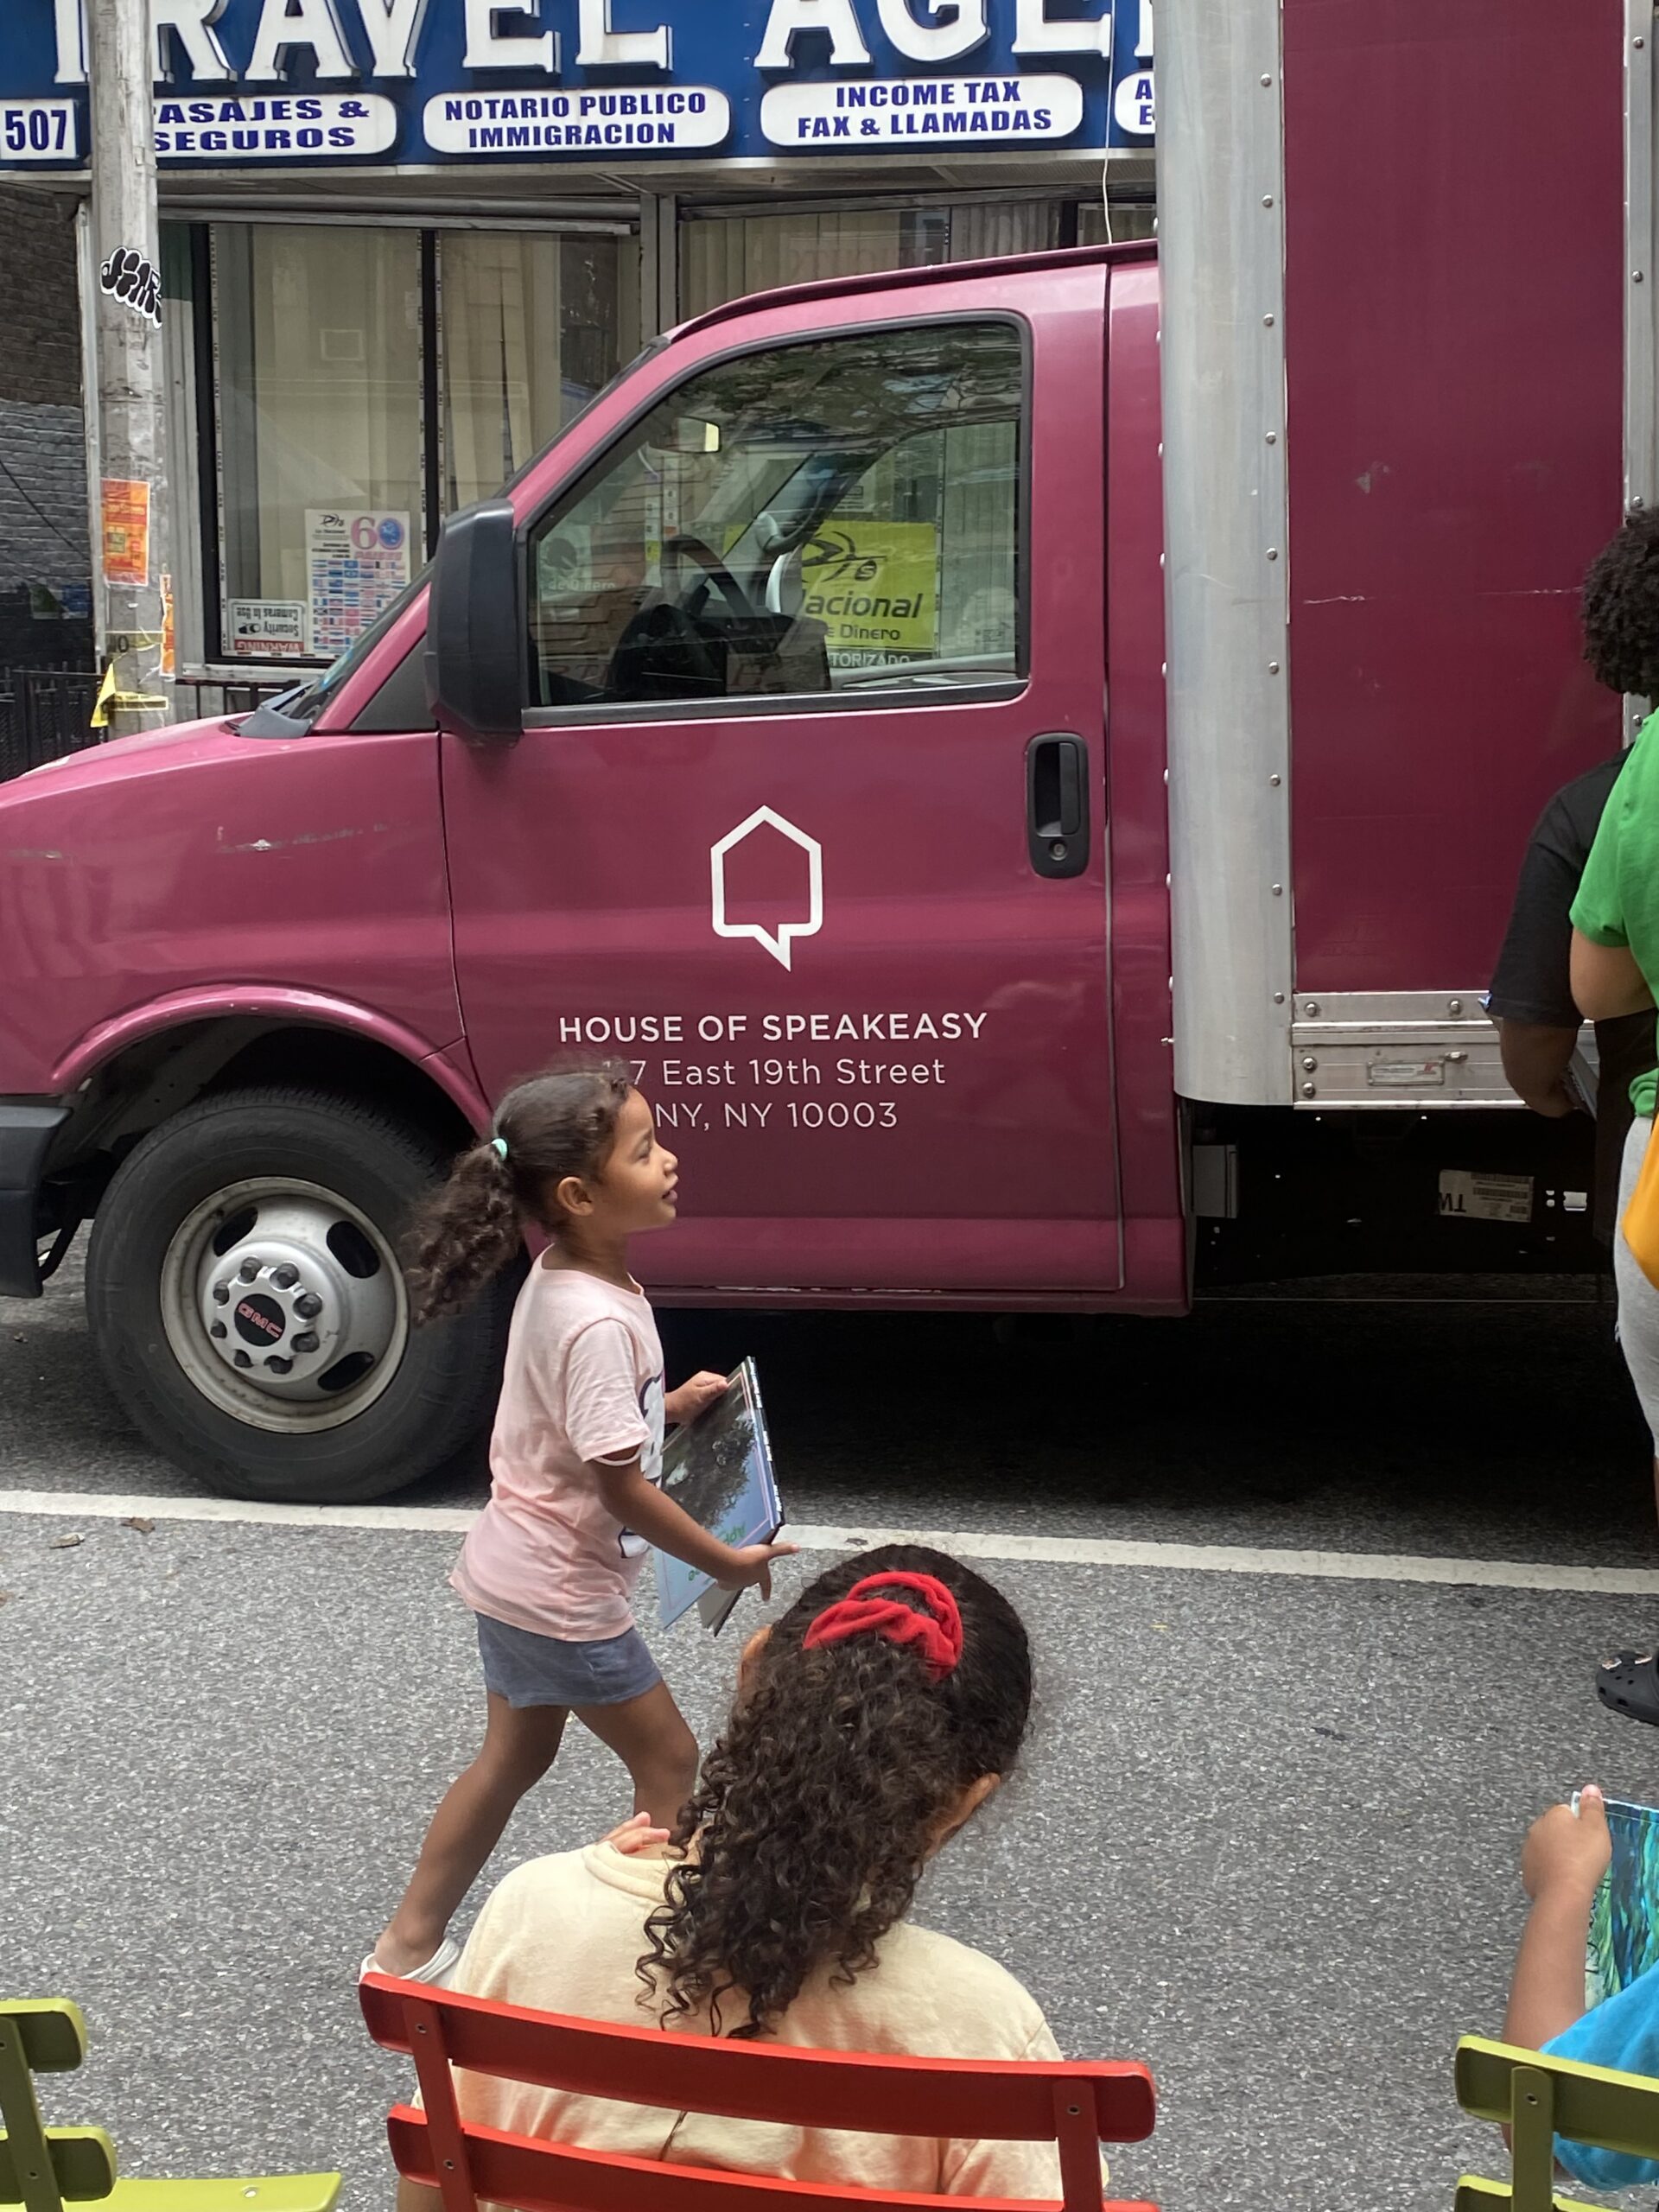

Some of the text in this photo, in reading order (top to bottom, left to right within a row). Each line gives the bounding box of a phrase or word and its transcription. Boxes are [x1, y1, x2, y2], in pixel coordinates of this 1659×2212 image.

[753, 0, 1154, 68] AGE
[445, 92, 706, 121] NOTARIO PUBLICO
[836, 81, 1021, 108] INCOME TAX
[153, 99, 370, 124] ASAJES &
[798, 108, 1052, 138] FAX & LLAMADAS
[1139, 105, 1156, 126] E
[4, 109, 67, 151] 507
[154, 127, 355, 151] SEGUROS
[468, 119, 676, 149] IMMIGRACION
[800, 589, 924, 619] acional
[264, 621, 299, 637] Security
[840, 624, 900, 640] Dinero
[236, 641, 300, 652] WARNING
[828, 652, 912, 667] TORIZADO
[559, 1012, 988, 1042] HOUSE OF SPEAKEASY
[663, 1059, 735, 1085] East
[749, 1058, 821, 1084] 19th
[836, 1058, 945, 1084] Street
[655, 1102, 898, 1130] NY, NY 10003
[238, 1302, 283, 1338] GMC
